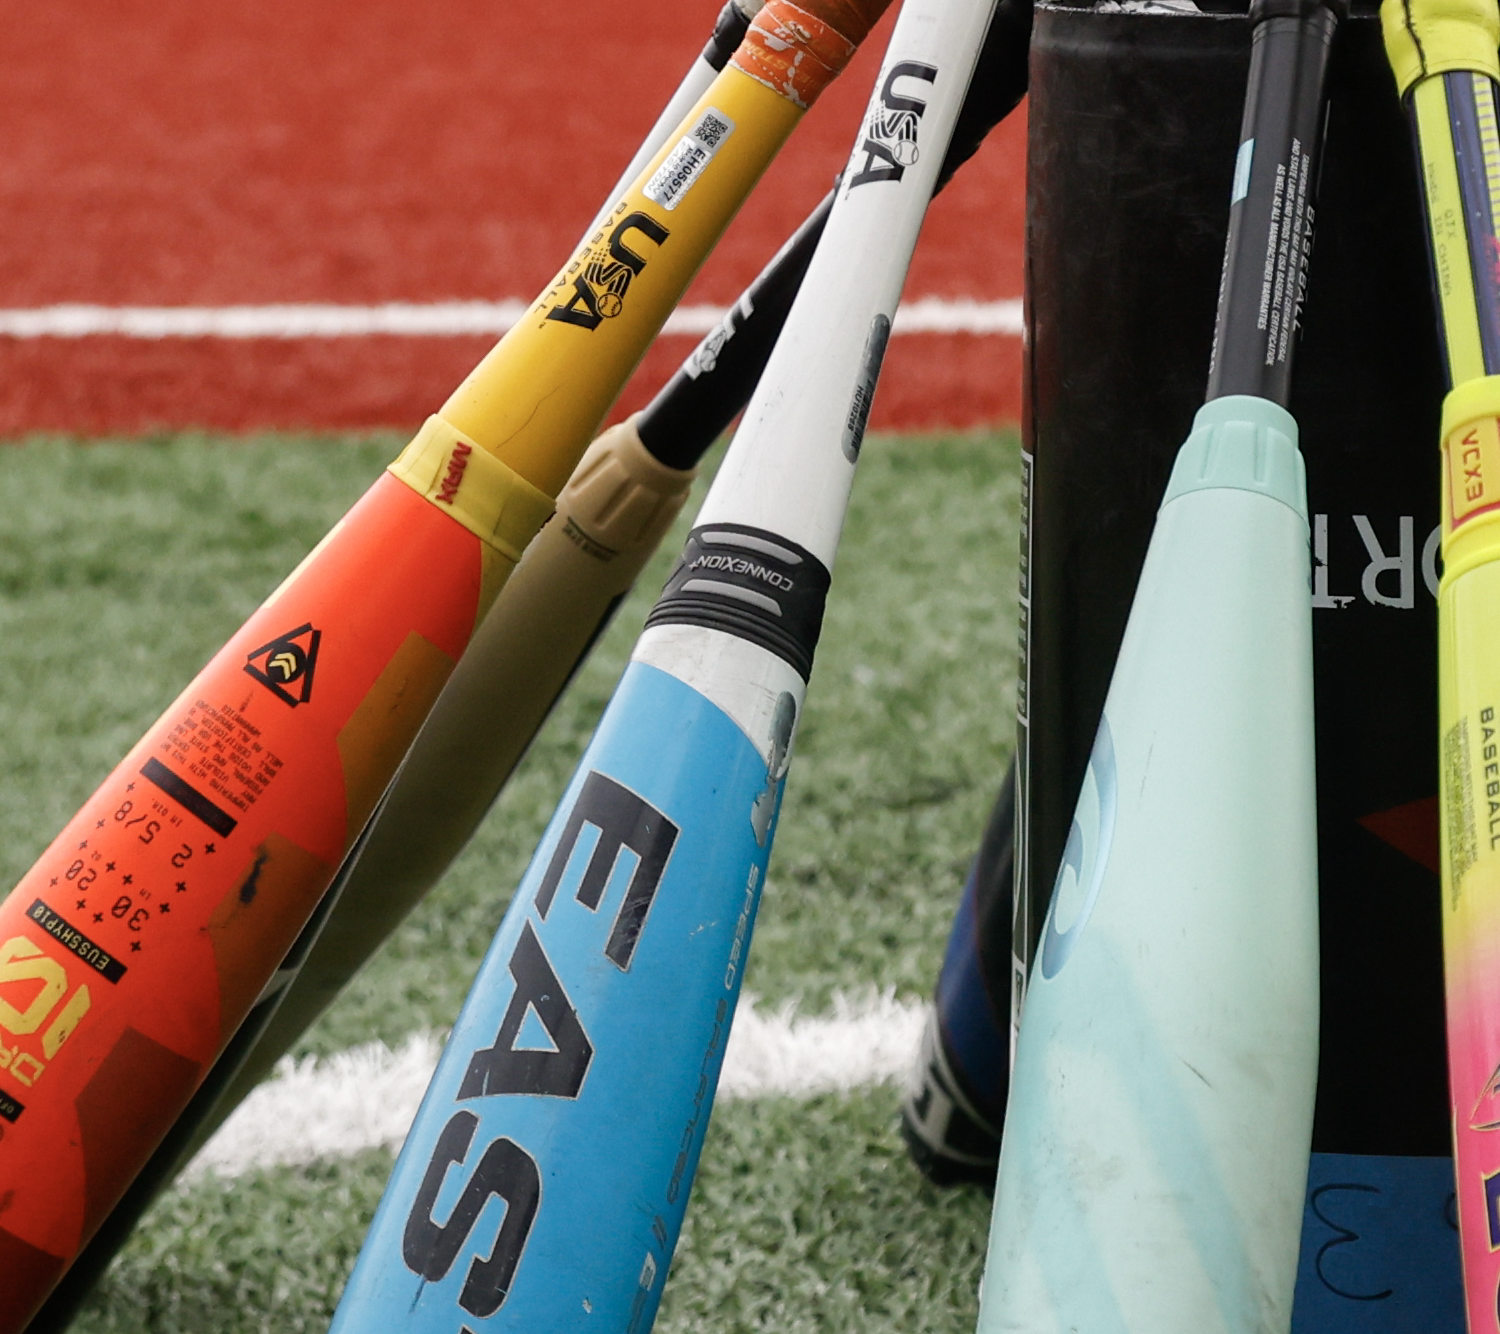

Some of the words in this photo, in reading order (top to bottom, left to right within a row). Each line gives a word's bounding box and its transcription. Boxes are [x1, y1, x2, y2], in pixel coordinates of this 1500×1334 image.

[845, 59, 939, 191] USA
[1276, 163, 1285, 175] AS
[1288, 155, 1298, 177] STATE
[1272, 195, 1281, 206] AS
[1273, 175, 1284, 195] WELL
[1285, 177, 1296, 200] LAWS
[1270, 206, 1280, 221] ALL
[1263, 221, 1278, 280] MANUFACTURER
[1276, 254, 1286, 270] USA
[1278, 239, 1288, 254] THE
[546, 210, 672, 333] USA
[1272, 270, 1284, 308] BASEBALL
[1257, 280, 1271, 330] WARRANTIES
[433, 441, 473, 505] MAX
[1461, 428, 1484, 501] VCX3
[110, 797, 162, 846] 5/8
[168, 841, 194, 870] 2
[62, 856, 99, 893] 20
[109, 891, 152, 933] 30
[722, 862, 761, 991] SPEED
